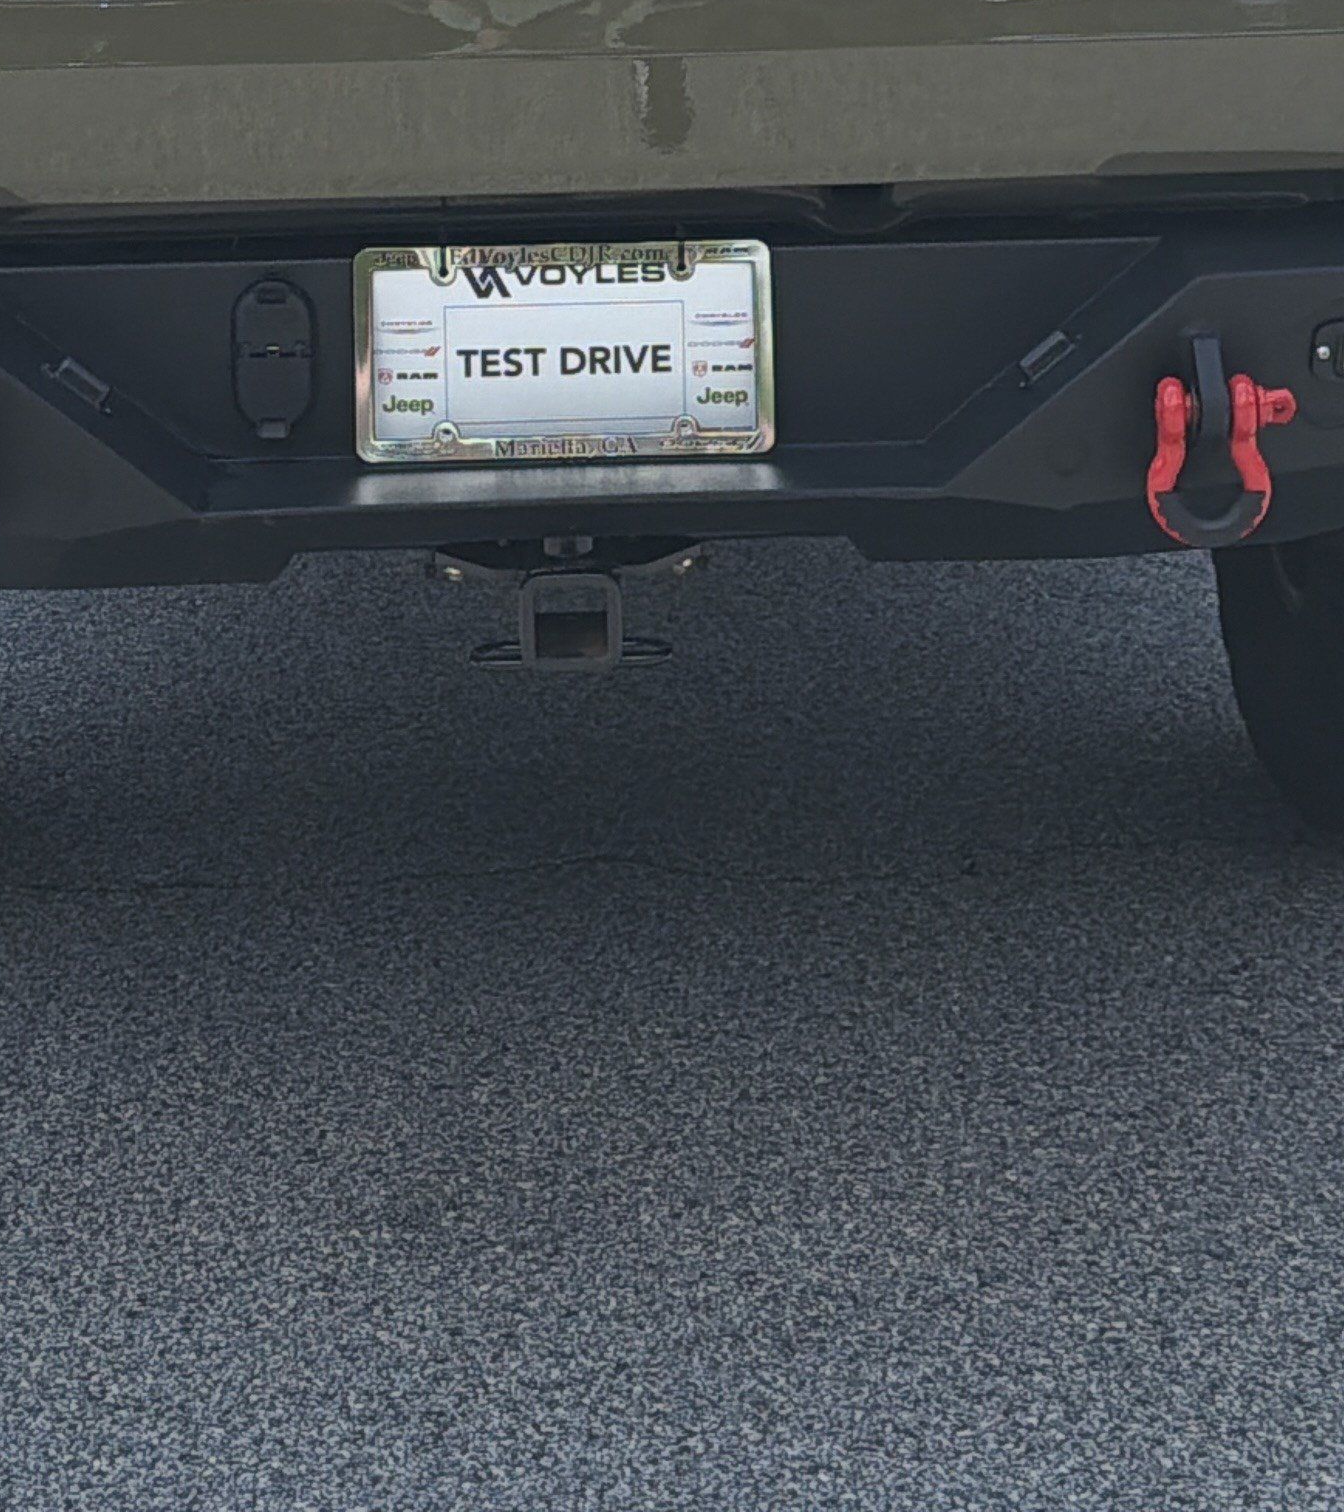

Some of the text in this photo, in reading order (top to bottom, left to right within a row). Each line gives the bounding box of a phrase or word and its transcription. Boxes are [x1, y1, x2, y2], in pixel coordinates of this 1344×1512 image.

[515, 262, 666, 285] VOYLES
[456, 343, 672, 378] TEST DRIVE
[382, 394, 435, 416] Jeep
[696, 386, 749, 407] Jeep
